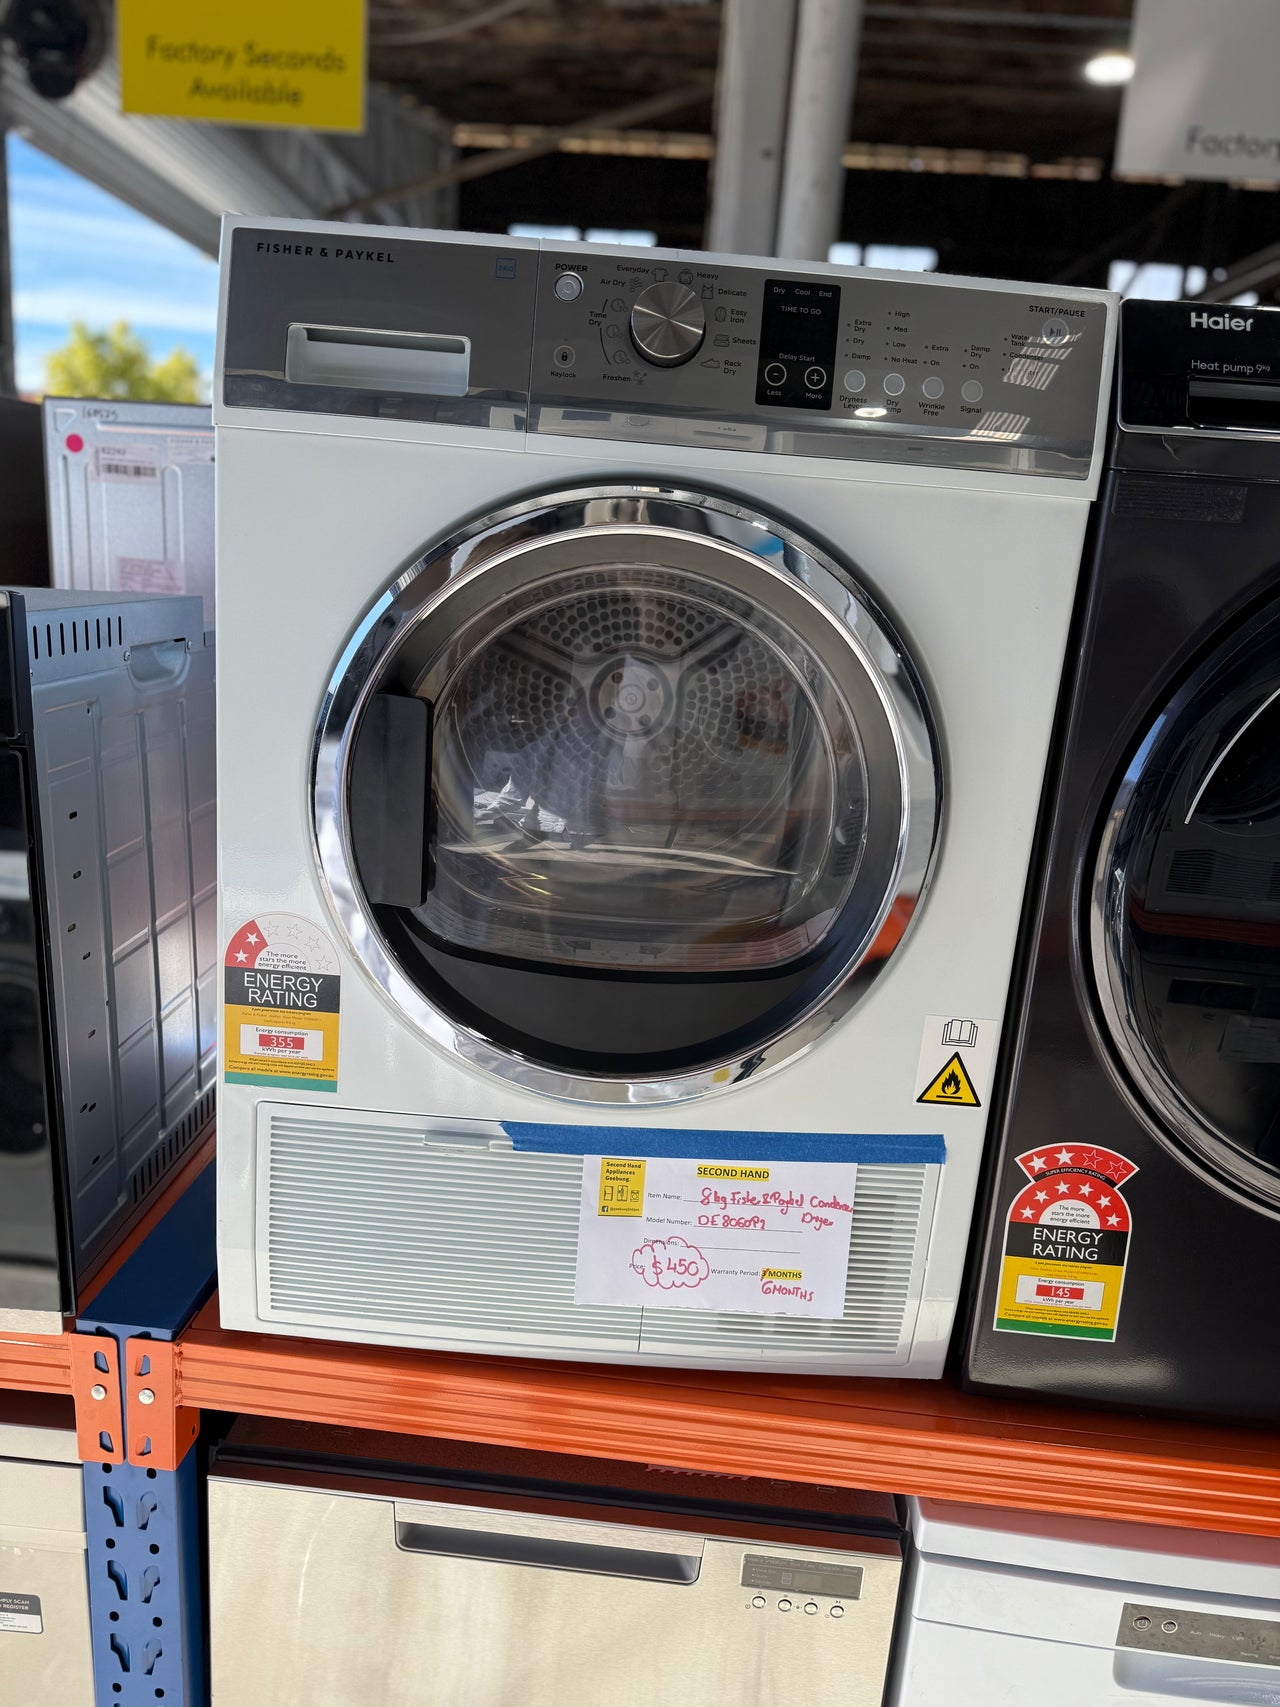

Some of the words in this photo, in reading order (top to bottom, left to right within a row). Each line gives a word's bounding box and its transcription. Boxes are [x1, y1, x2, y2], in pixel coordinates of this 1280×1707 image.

[146, 34, 236, 70] Factory
[243, 40, 347, 73] Seconds
[190, 77, 302, 107] Available
[256, 242, 313, 257] FISHER
[319, 248, 329, 257] &
[336, 249, 395, 263] PAYKEL
[555, 263, 588, 272] POWER
[617, 265, 650, 275] Everyday
[696, 271, 719, 281] Heavy
[612, 280, 626, 288] Dry
[718, 288, 747, 297] Delicate
[773, 286, 786, 296] Dry
[795, 288, 811, 297] Cool
[818, 290, 832, 298] End
[589, 311, 607, 319] Time
[730, 309, 747, 317] Easy
[781, 305, 798, 314] TIME
[799, 306, 807, 314] TO
[808, 307, 821, 316] GO
[894, 311, 911, 319] High
[1028, 305, 1086, 318] START/PAUSE
[588, 319, 602, 327] Dry
[854, 319, 872, 327] Extra
[1190, 312, 1254, 332] Haier
[853, 325, 866, 333] Dry
[893, 325, 908, 333] Med
[732, 337, 757, 345] Sheets
[852, 336, 865, 346] Dry
[892, 340, 907, 349] Low
[931, 344, 949, 353] Extra
[970, 344, 990, 354] Damp
[779, 352, 796, 362] Delay
[797, 353, 815, 362] Start
[851, 353, 872, 362] Damp
[970, 351, 983, 359] Dry
[1009, 352, 1044, 361] Condenser
[724, 360, 742, 368] Rack
[901, 356, 918, 365] Heat
[723, 367, 736, 376] Dry
[969, 363, 980, 371] On
[1191, 359, 1220, 371] Heat
[1222, 363, 1254, 375] pump
[1255, 364, 1271, 374] 9kg
[550, 371, 576, 379] Keylock
[602, 374, 631, 382] Freshen
[767, 389, 782, 397] Less
[805, 392, 823, 400] More
[839, 395, 868, 404] Dryness
[886, 399, 899, 407] Dry
[918, 402, 945, 411] Wrinkle
[960, 405, 982, 415] Signal
[923, 408, 940, 416] Free
[266, 950, 279, 958] The
[258, 962, 280, 970] energy
[280, 962, 307, 971] efficient
[244, 972, 324, 993] ENERGY
[248, 989, 318, 1008] RATING
[274, 1029, 309, 1037] consumption
[270, 1036, 294, 1048] 355
[696, 1166, 739, 1178] SECOND
[739, 1169, 770, 1180] HAND
[1045, 1169, 1061, 1177] SUPER
[1060, 1167, 1087, 1176] EFFICIENCY
[1087, 1170, 1106, 1181] RATING
[646, 1216, 665, 1225] Model
[666, 1218, 693, 1227] Number:
[1068, 1217, 1090, 1225] efficient
[1032, 1227, 1104, 1245] ENERGY
[1032, 1245, 1098, 1261] RATING
[710, 1268, 739, 1276] Warranty
[739, 1269, 761, 1277] Period:
[768, 1271, 802, 1279] MONTHS
[1050, 1287, 1070, 1297] 145
